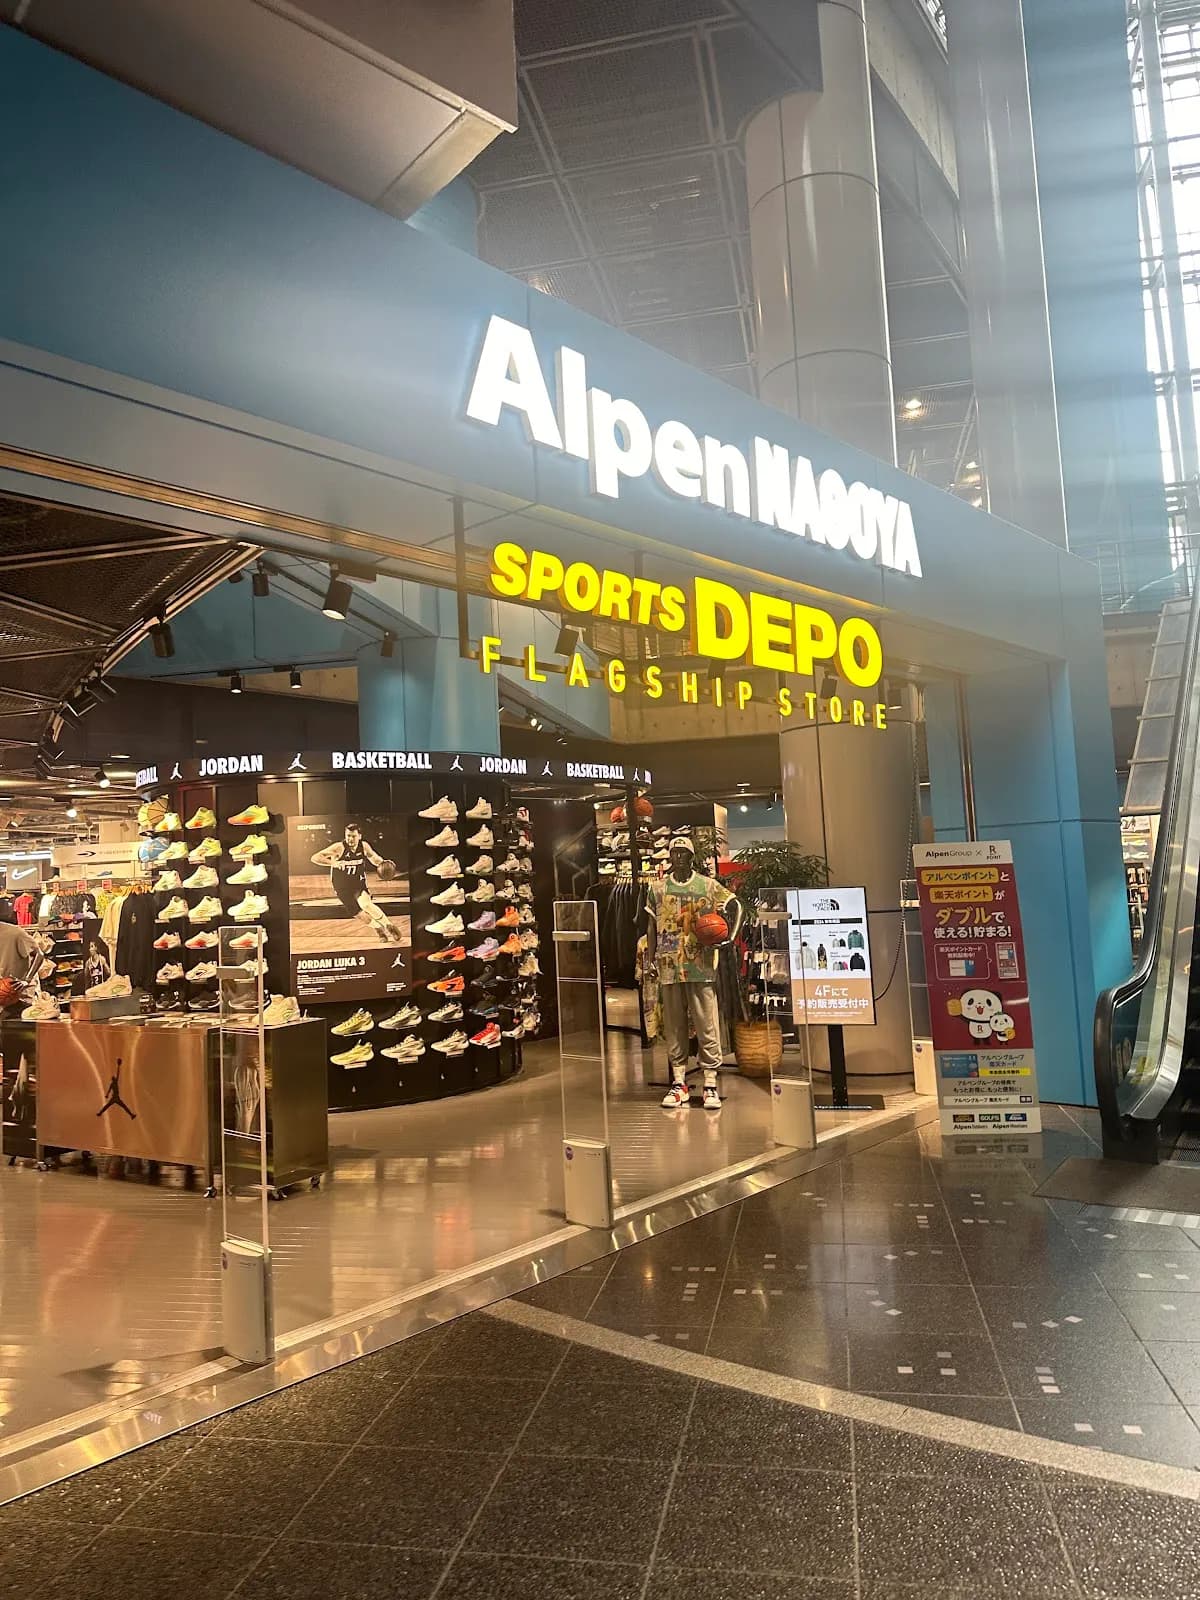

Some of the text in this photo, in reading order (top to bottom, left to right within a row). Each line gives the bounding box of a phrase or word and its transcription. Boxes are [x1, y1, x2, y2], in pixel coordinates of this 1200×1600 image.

[465, 314, 923, 578] Alpen NAGOYA
[489, 542, 883, 688] SPORTS DEPO
[481, 636, 888, 730] FLAGSHIP STORE
[199, 755, 264, 776] JORDAN
[332, 752, 432, 769] BASKETBALL
[480, 756, 527, 775] JORDAN
[567, 762, 625, 780] BASKETBALL
[936, 905, 1005, 925] ダブルで
[297, 958, 332, 970] JORDAN
[334, 957, 357, 967] LUKA
[358, 956, 366, 966] 3
[815, 985, 849, 997] 4Fにて
